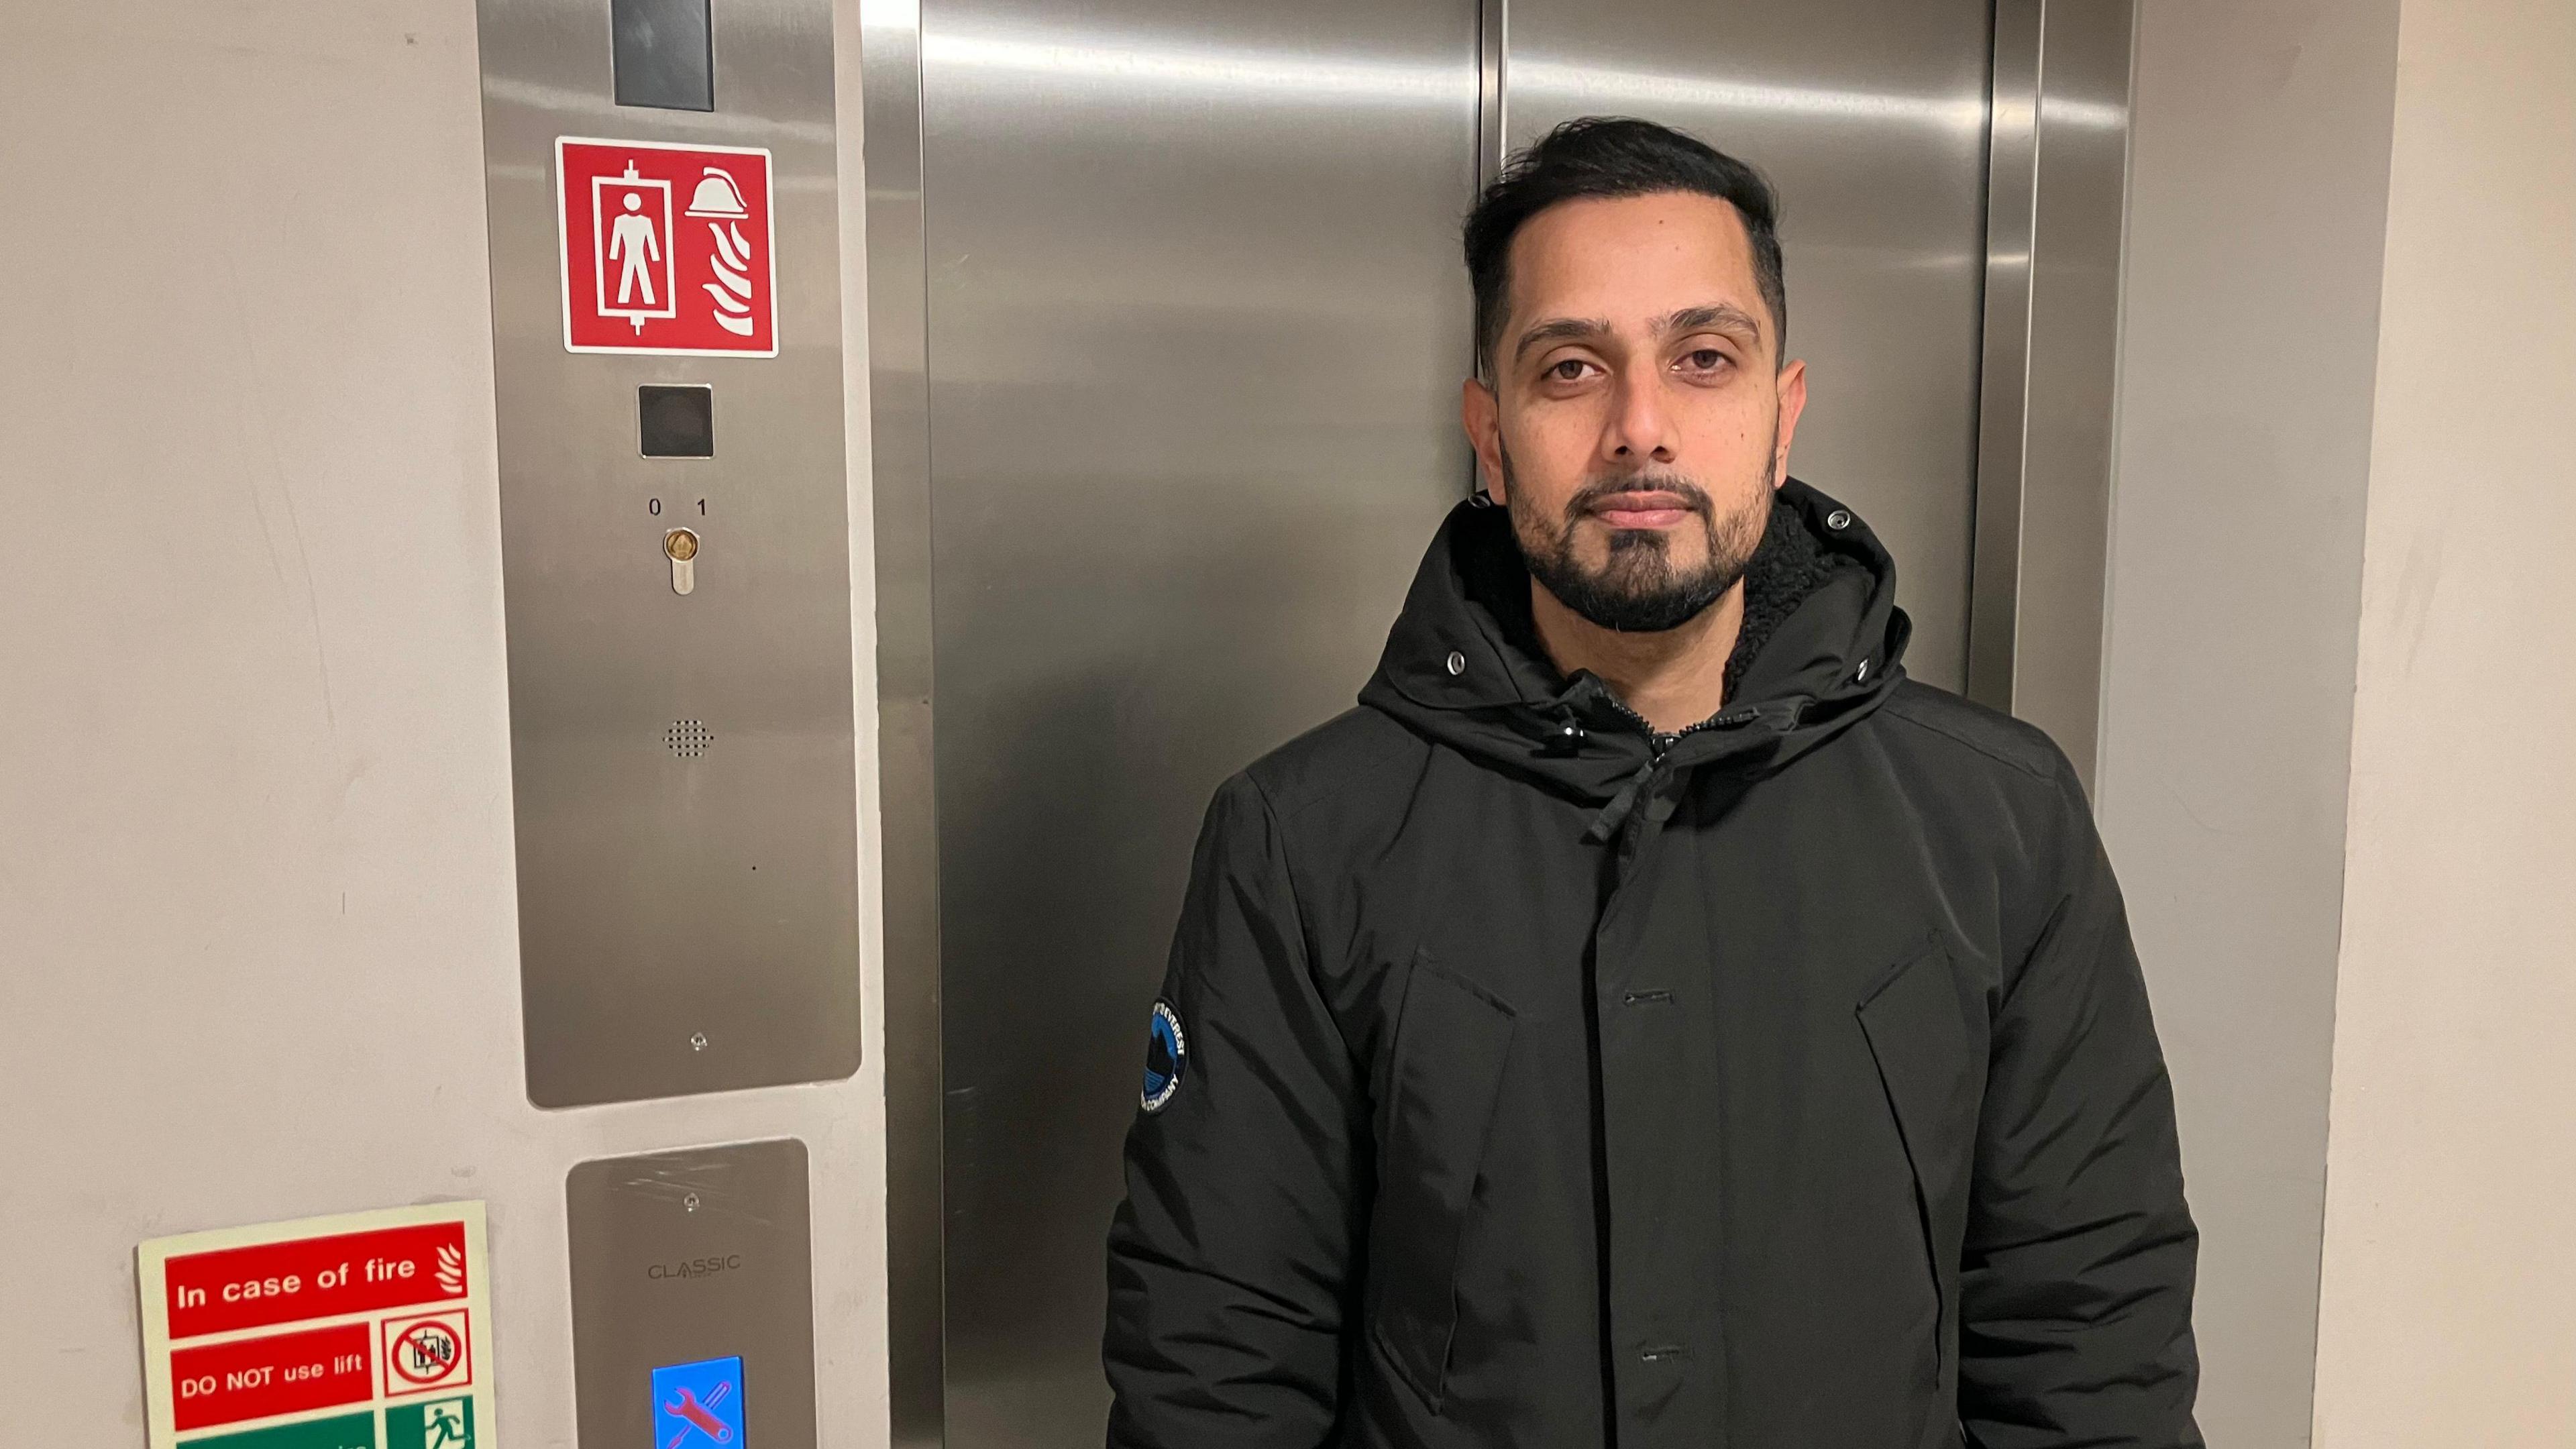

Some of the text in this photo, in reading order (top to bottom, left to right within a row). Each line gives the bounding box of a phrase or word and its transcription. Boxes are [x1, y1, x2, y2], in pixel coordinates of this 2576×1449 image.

[649, 498, 706, 517] 0 1
[1147, 1073, 1179, 1112] COMPANY
[177, 1258, 415, 1309] In case of fire
[647, 1254, 741, 1280] CLASSIC
[181, 1354, 363, 1399] DO NOT use lift
